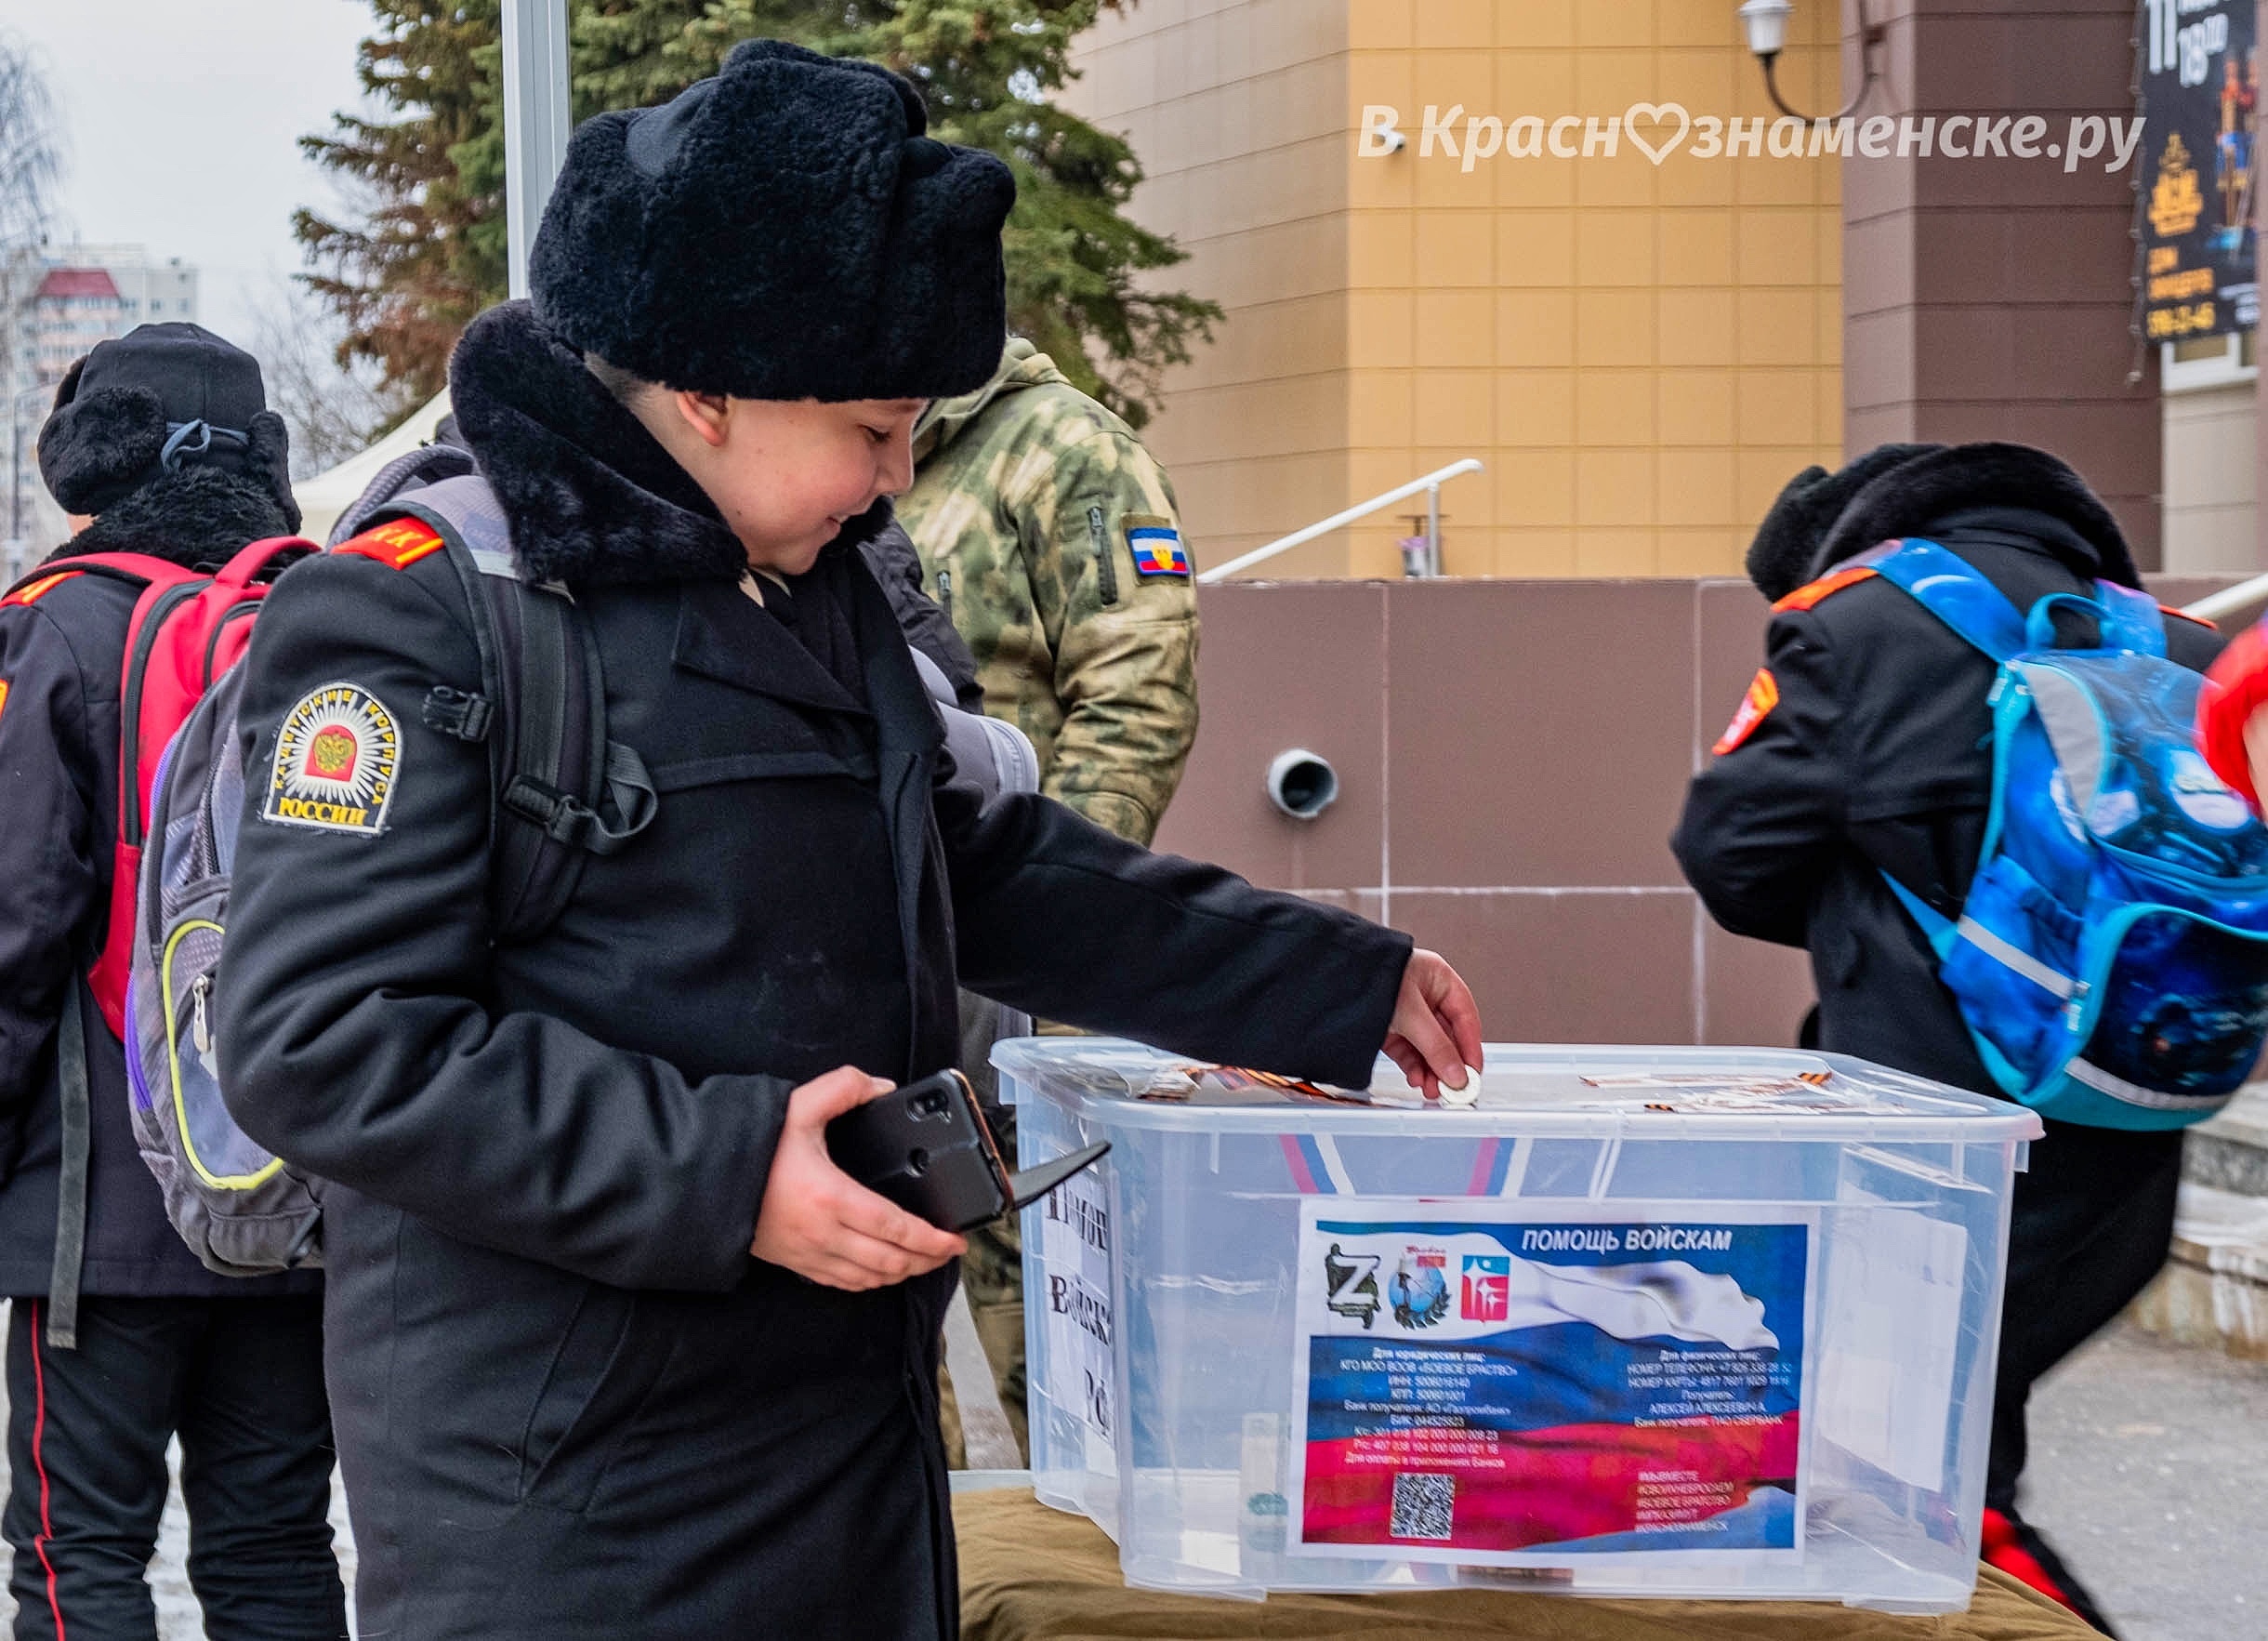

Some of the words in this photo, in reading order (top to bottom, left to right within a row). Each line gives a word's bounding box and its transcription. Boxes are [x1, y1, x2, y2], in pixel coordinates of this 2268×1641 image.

[278, 797, 368, 826] РОССИИ
[1522, 1229, 1620, 1254] ПОМОЩЬ
[1624, 1224, 1733, 1251] ВОЙСКАМ
